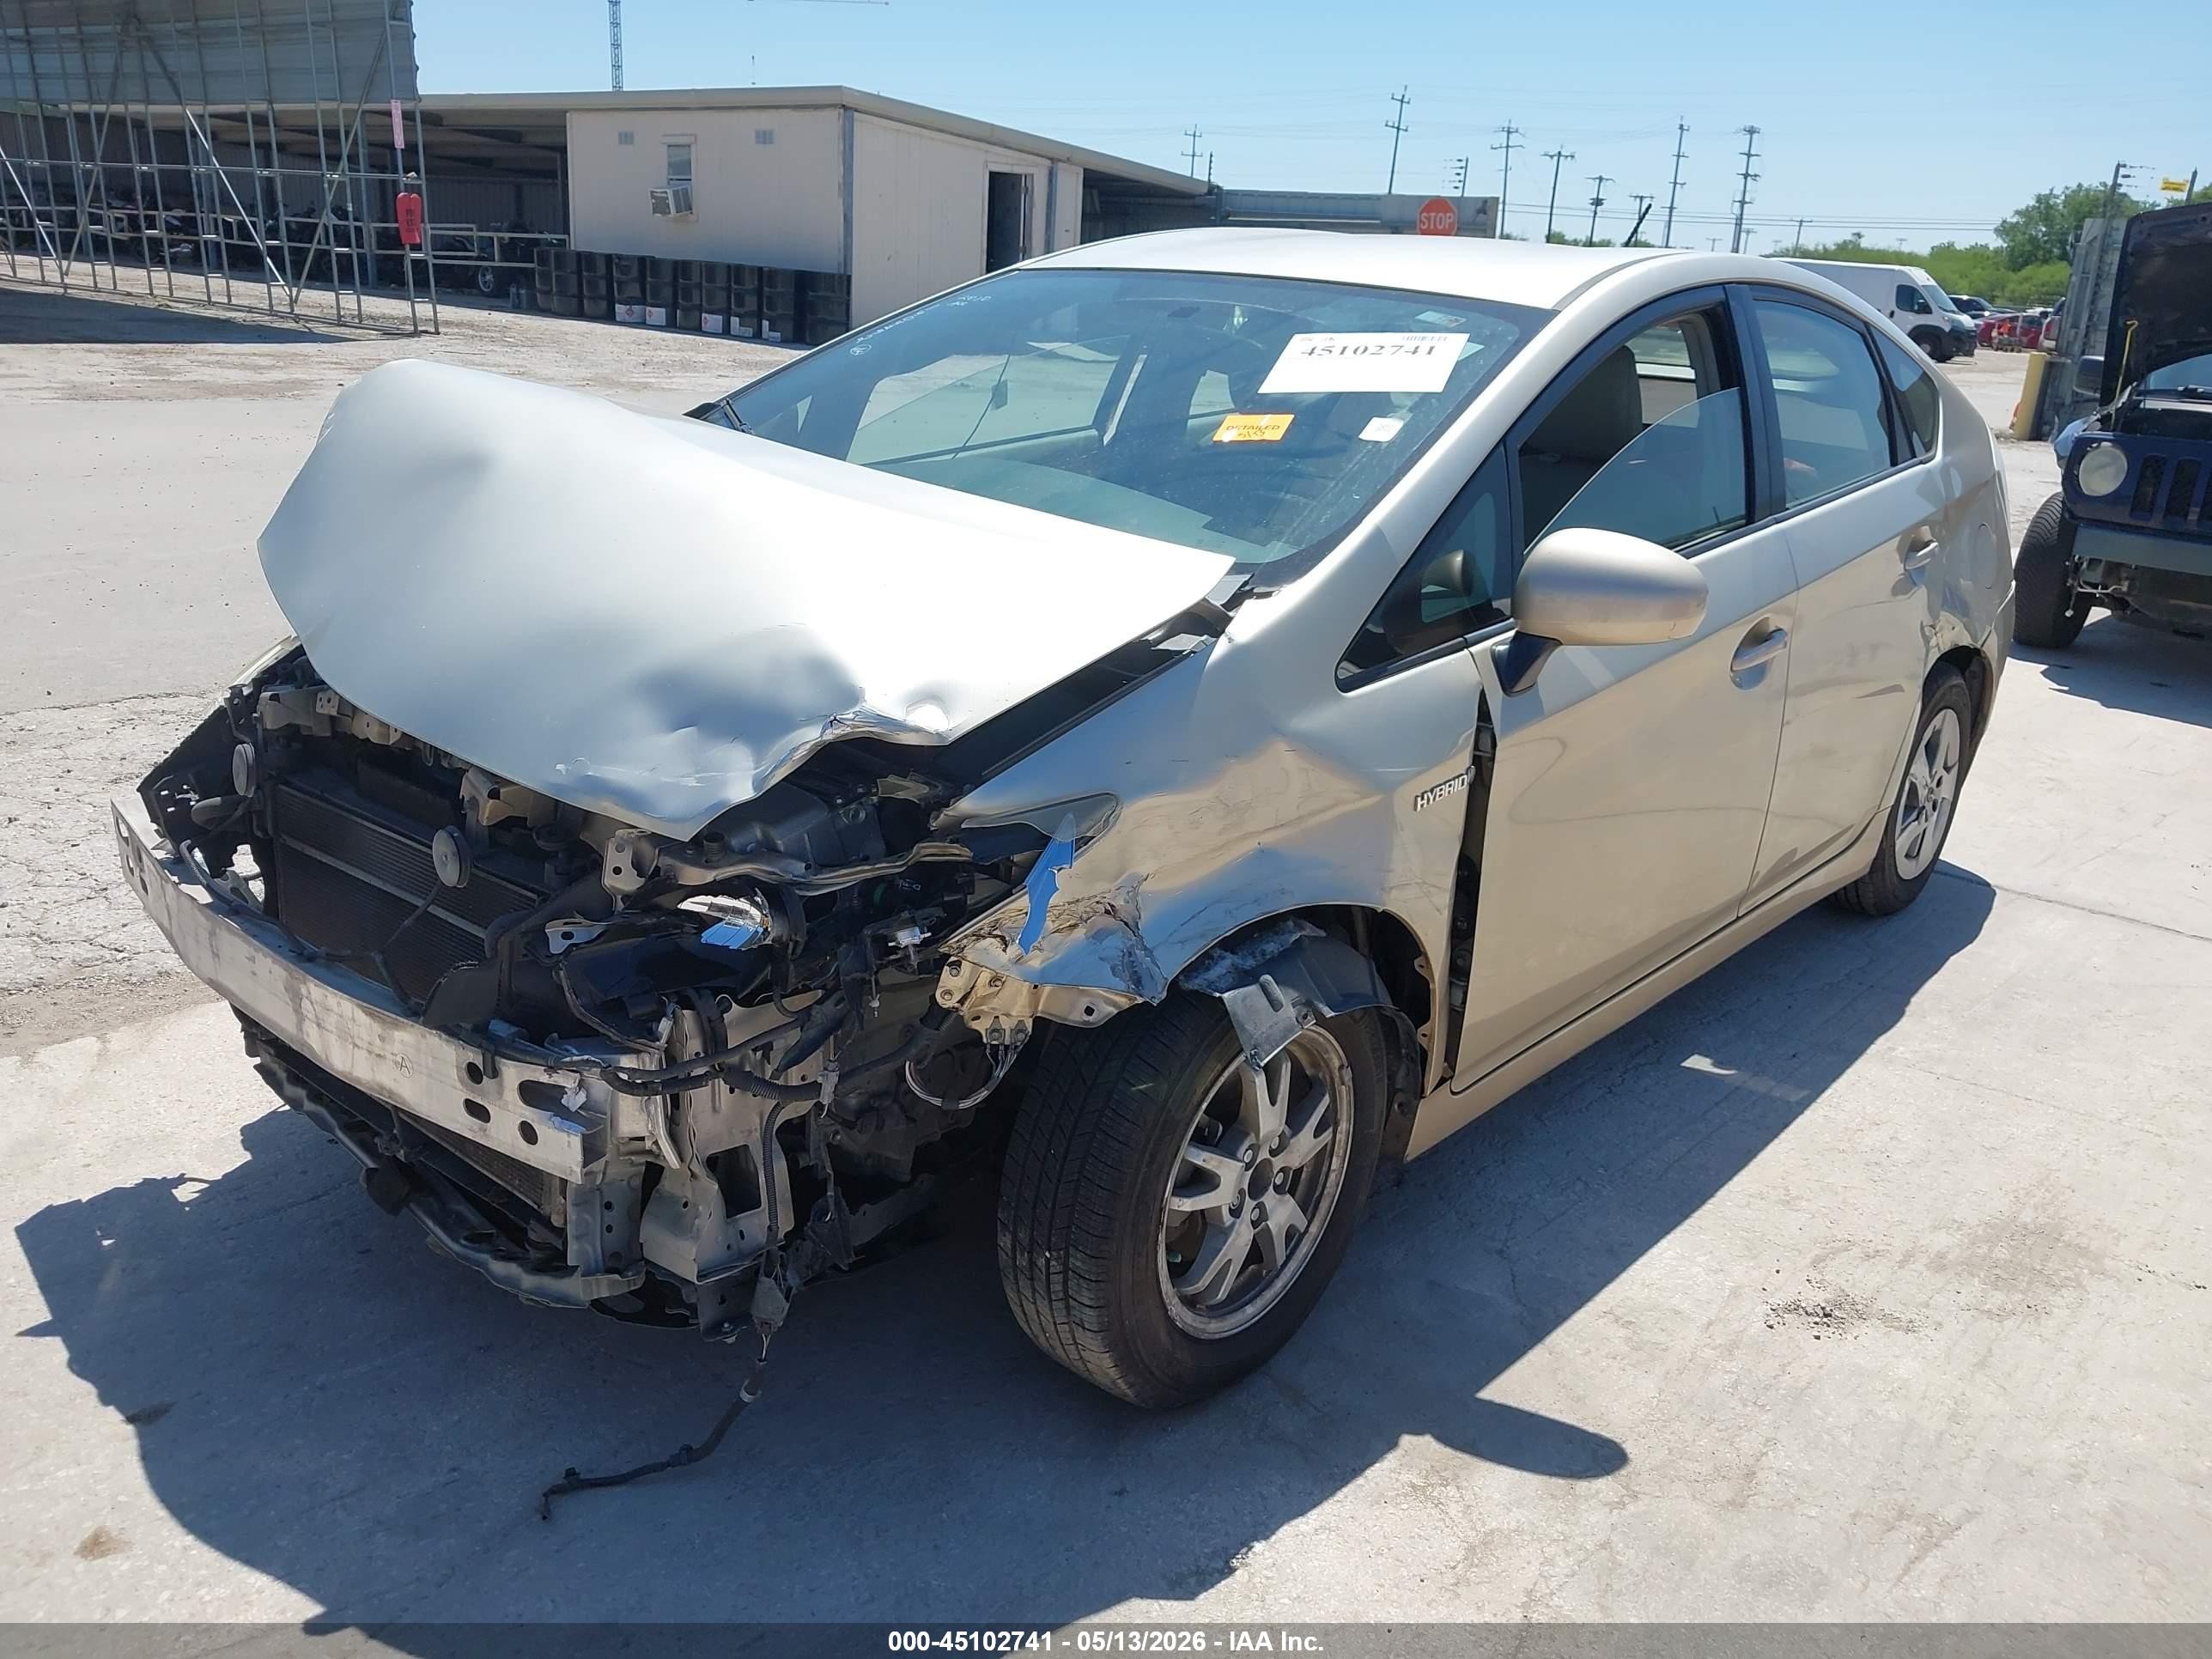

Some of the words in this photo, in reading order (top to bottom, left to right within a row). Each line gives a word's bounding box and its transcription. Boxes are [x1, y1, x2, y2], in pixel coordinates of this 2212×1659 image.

[1420, 212, 1453, 229] STOP
[1301, 344, 1436, 356] 45102741
[1416, 774, 1468, 812] HYBRID
